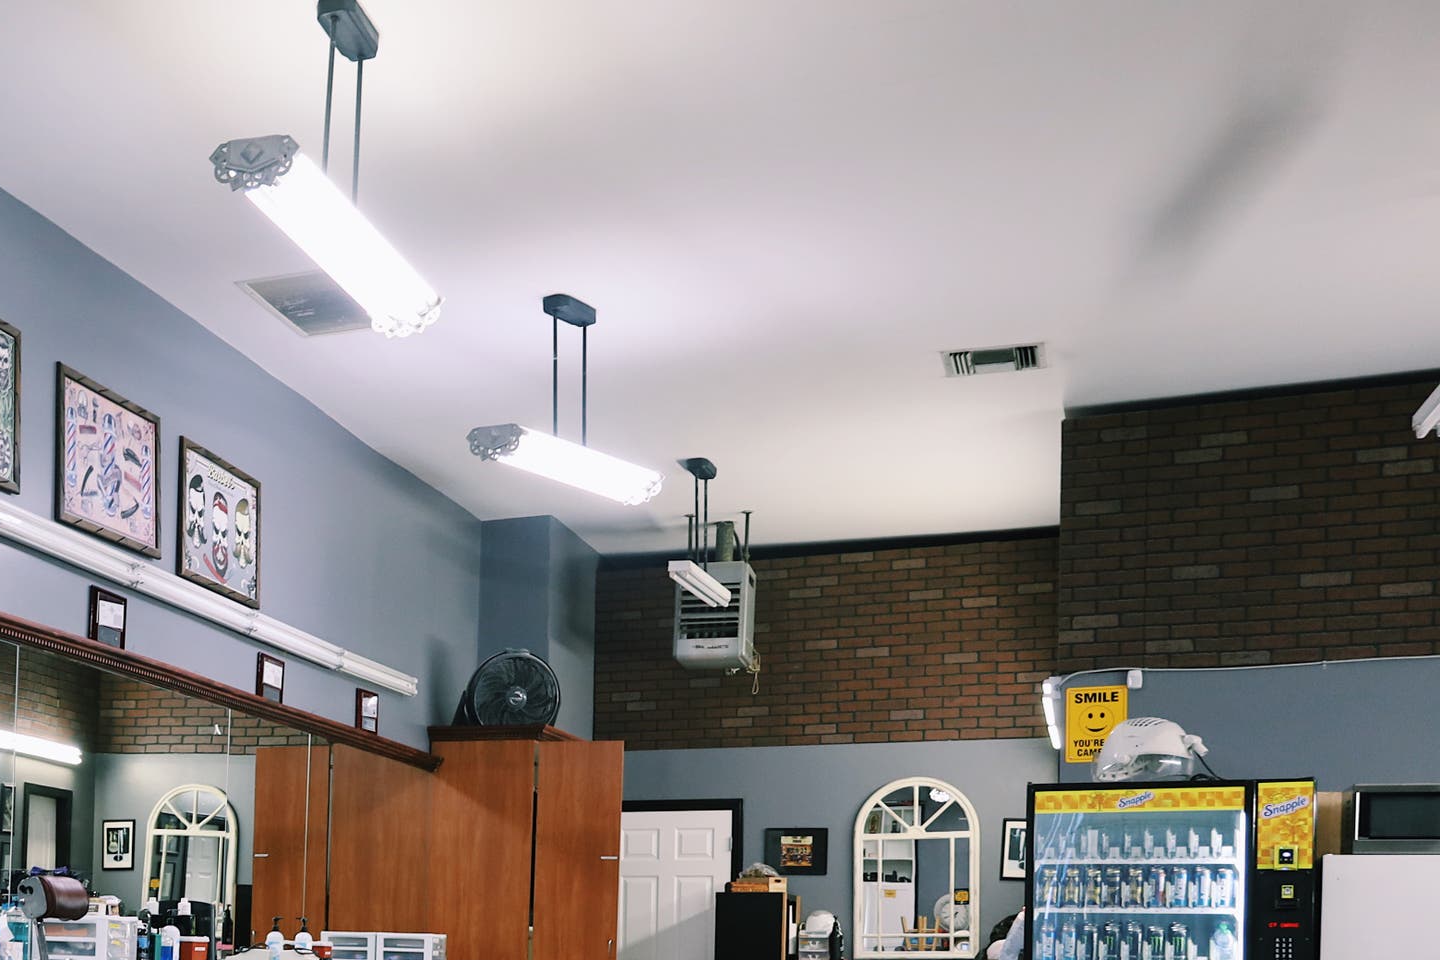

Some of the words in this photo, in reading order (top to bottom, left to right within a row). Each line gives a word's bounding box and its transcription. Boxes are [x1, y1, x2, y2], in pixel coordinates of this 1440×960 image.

[1074, 691, 1120, 704] SMILE
[1073, 738, 1105, 748] YOU'RE
[1119, 791, 1152, 808] Snapple
[1263, 796, 1307, 817] Snapple
